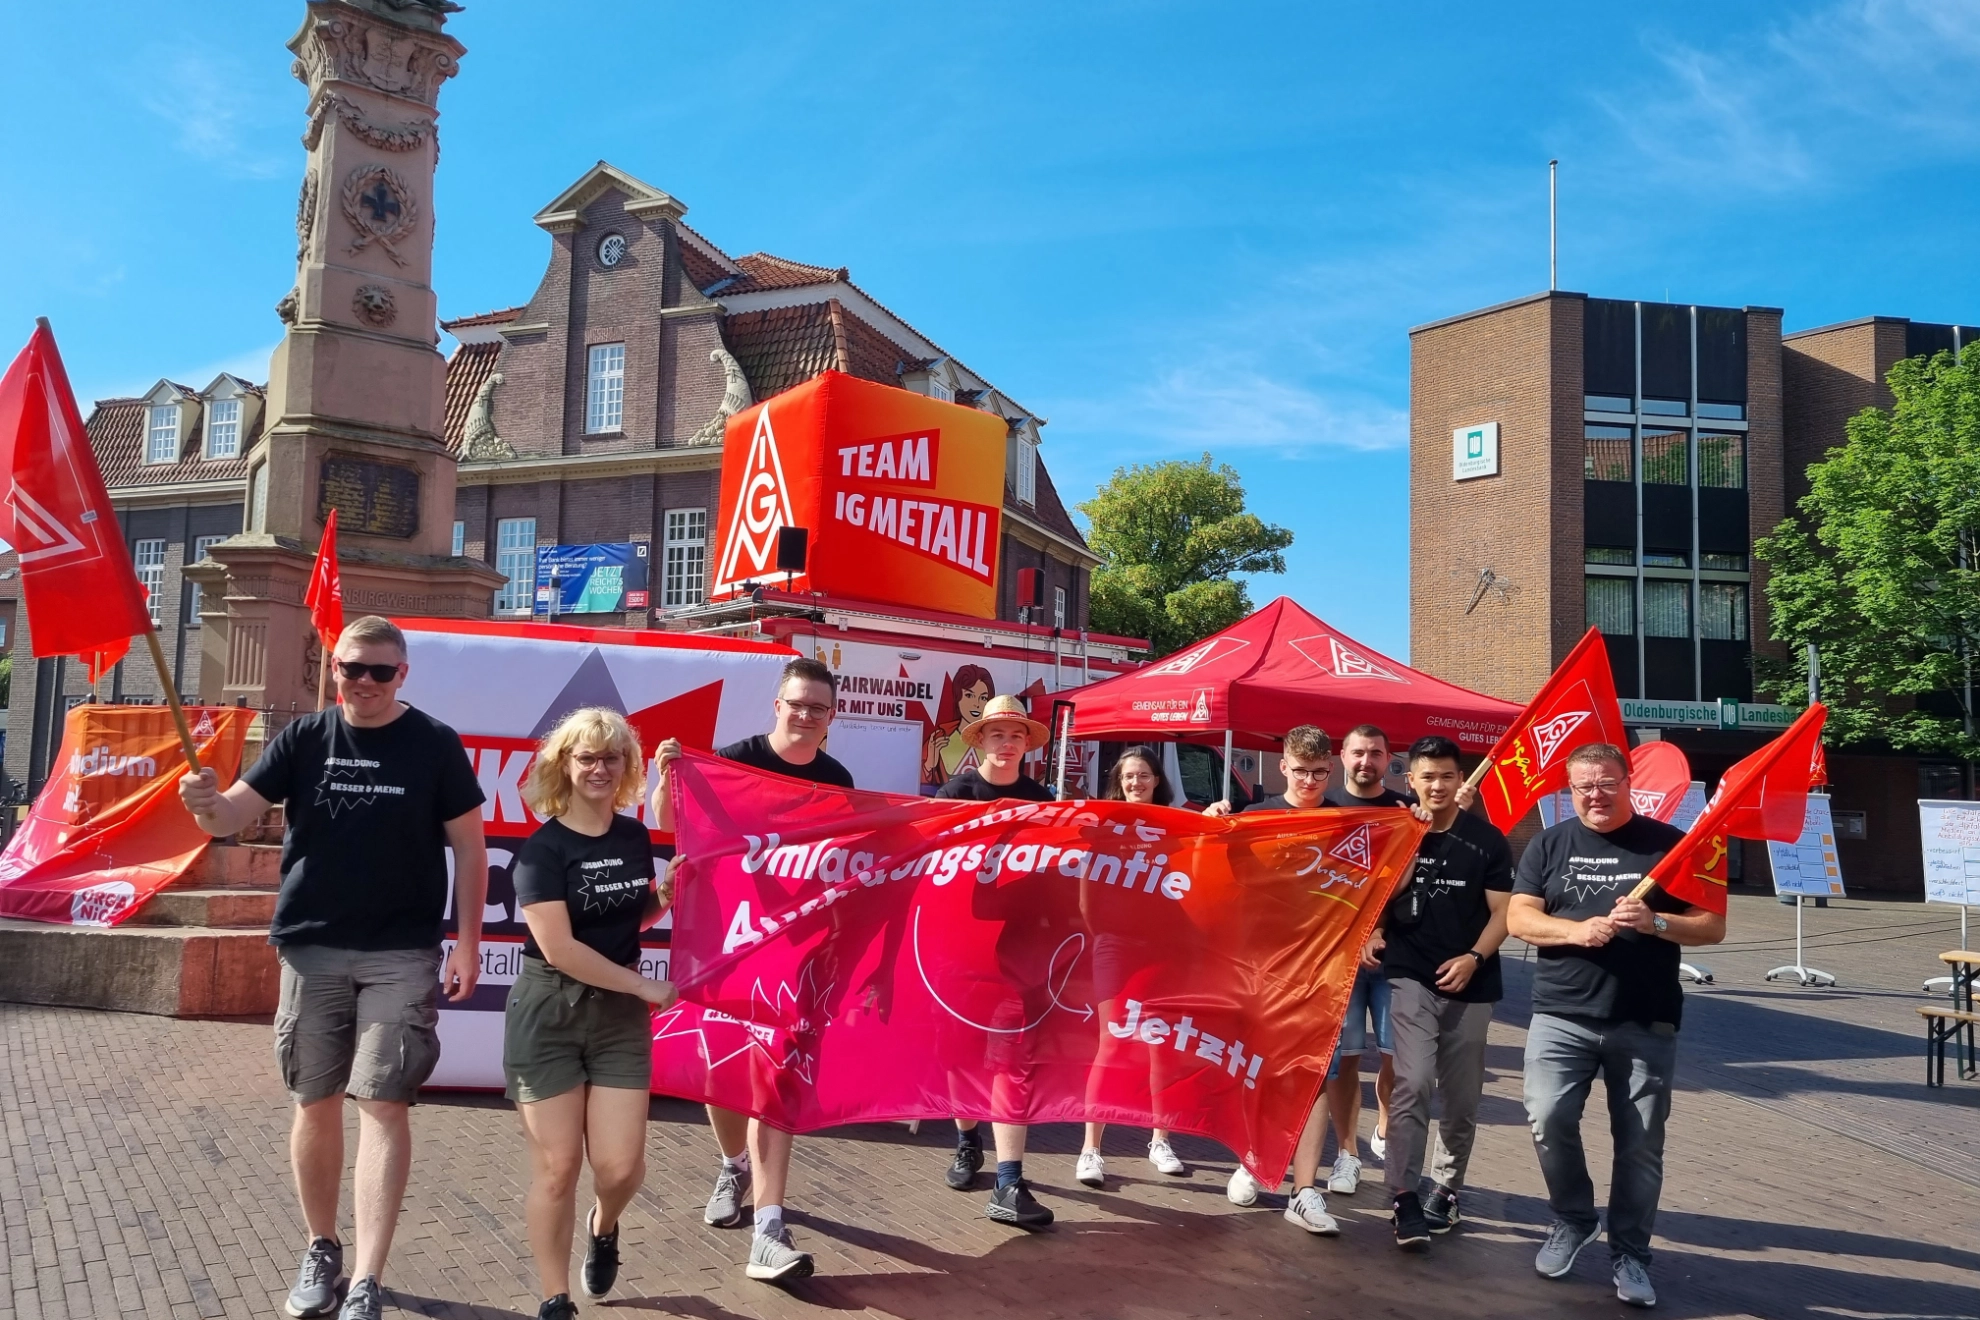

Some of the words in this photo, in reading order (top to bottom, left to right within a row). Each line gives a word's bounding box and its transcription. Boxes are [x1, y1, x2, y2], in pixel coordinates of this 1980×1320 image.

[838, 437, 930, 481] TEAM
[835, 491, 865, 527] IG
[868, 496, 990, 578] METALL
[591, 566, 624, 577] JETZT
[589, 577, 623, 586] REICHT'S
[589, 586, 623, 594] WOCHEN
[849, 700, 874, 715] MIT
[878, 702, 903, 717] UNS
[1132, 700, 1166, 711] GEMEINSAM
[1166, 699, 1178, 710] FÜR
[1178, 700, 1189, 709] EIN
[1151, 712, 1169, 722] GUTES
[1170, 712, 1188, 721] LEBEN
[1624, 702, 1717, 722] Oldenburgische
[1742, 707, 1797, 724] Landesba
[1427, 715, 1479, 731] GEMEINSAM
[1480, 721, 1496, 733] FÜR
[1459, 732, 1484, 744] GUTES
[324, 757, 381, 769] AUSBILDUNG
[330, 782, 365, 793] BESSER
[365, 784, 373, 793] &
[373, 785, 405, 795] MEHR!
[581, 858, 623, 869] AUSBILDUNG
[1569, 856, 1619, 865] AUSBILDUNG
[1446, 879, 1466, 887] MEHR!
[1577, 873, 1606, 882] BESSER
[1615, 873, 1642, 881] MEHR!
[595, 882, 623, 893] BESSER
[624, 881, 631, 889] &
[1107, 998, 1264, 1090] Jetzt!
